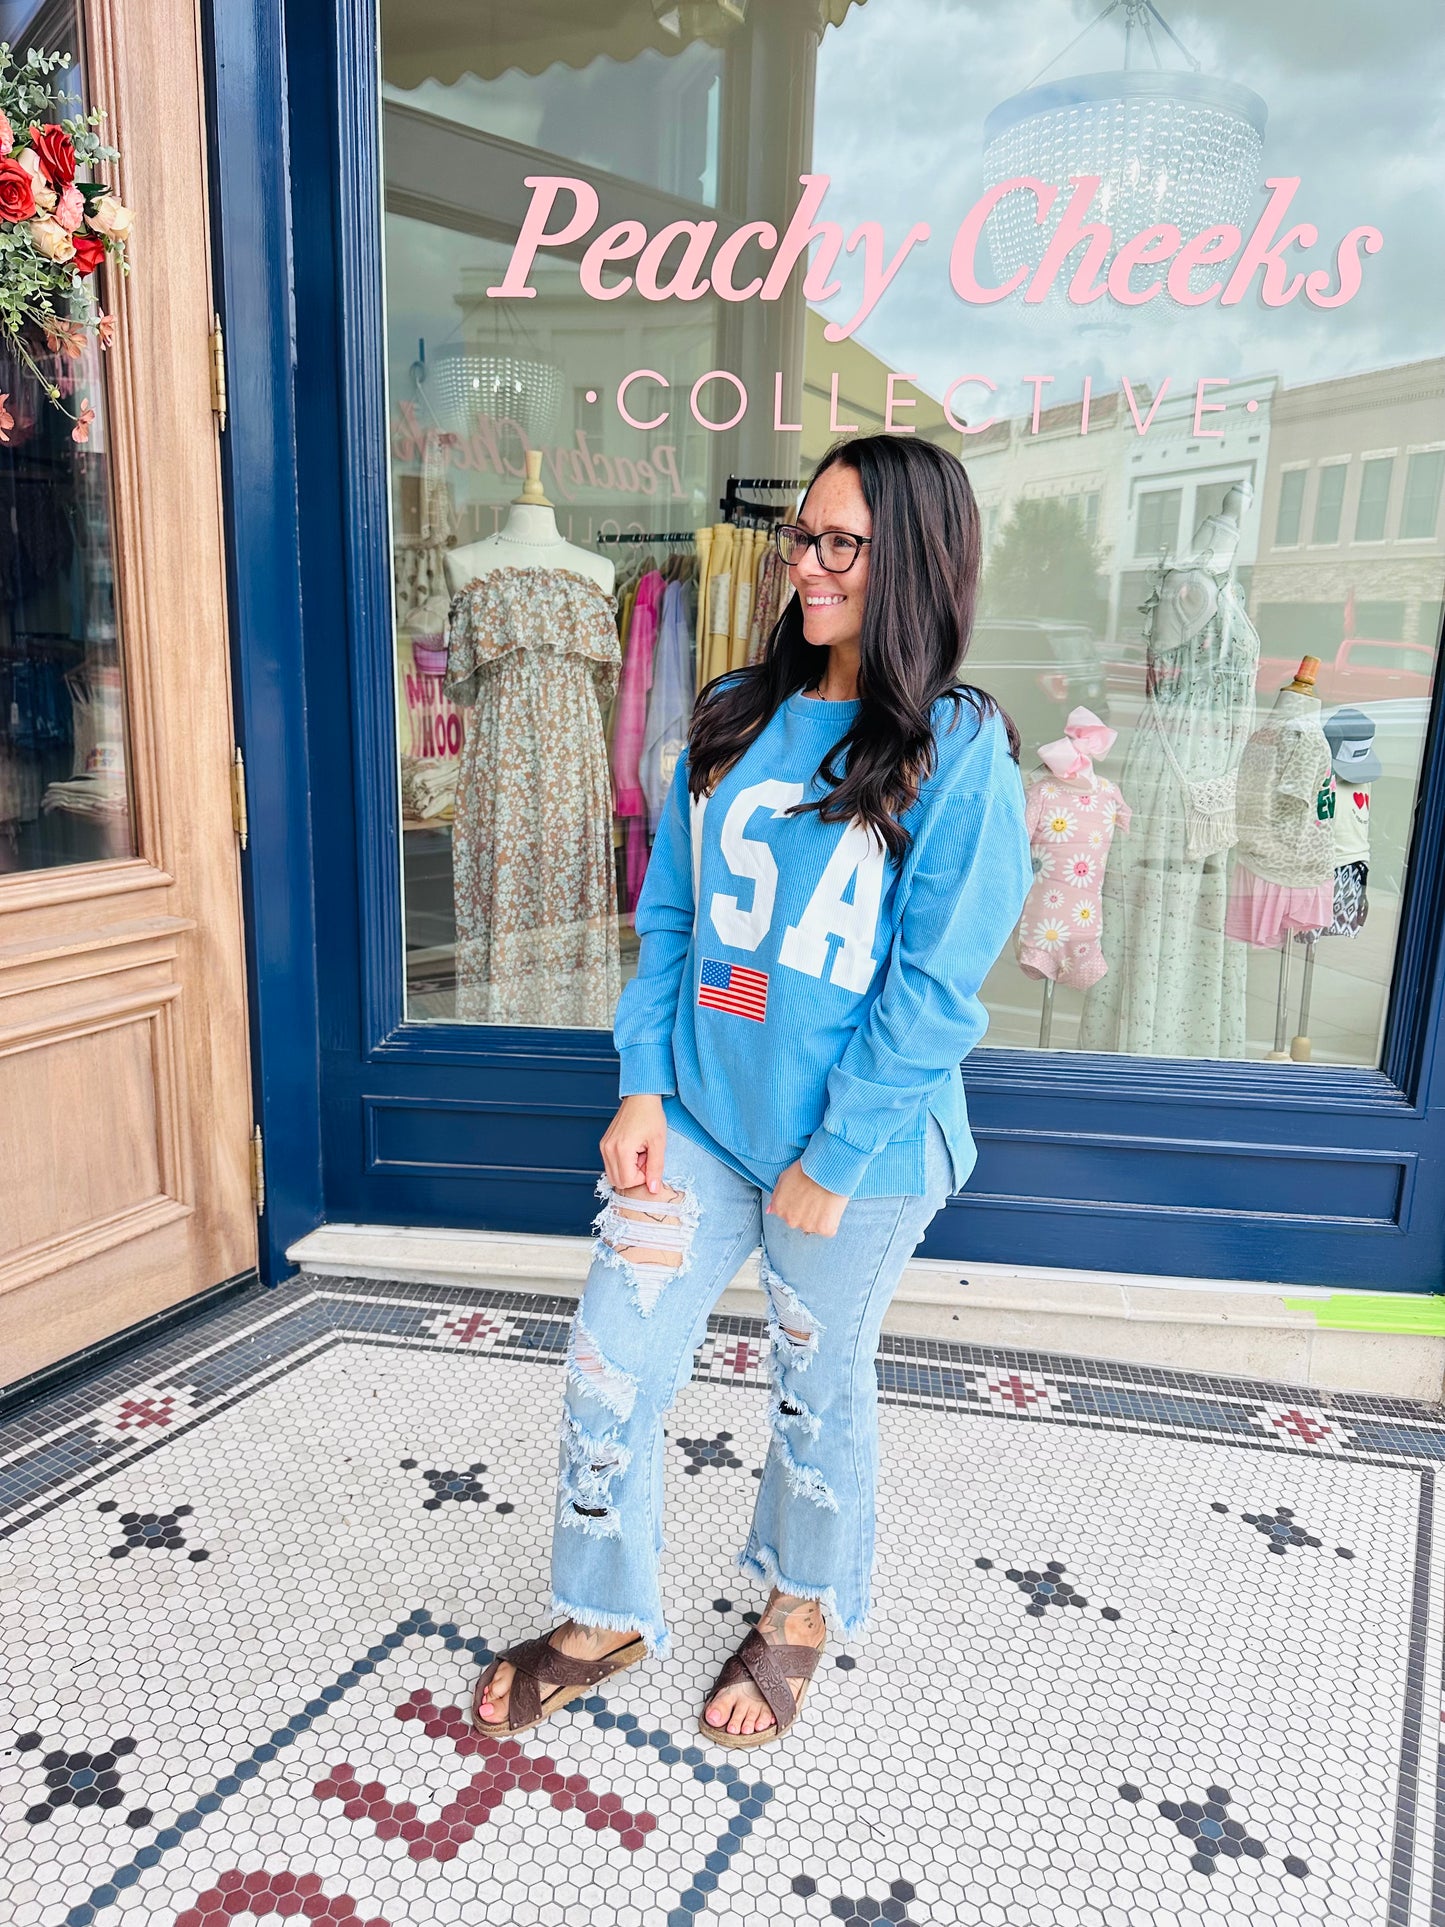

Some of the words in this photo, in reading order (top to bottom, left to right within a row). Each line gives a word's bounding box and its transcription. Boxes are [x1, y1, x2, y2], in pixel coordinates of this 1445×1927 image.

[486, 174, 930, 342] Peachy
[949, 175, 1384, 309] Cheeks
[423, 713, 465, 758] HOO
